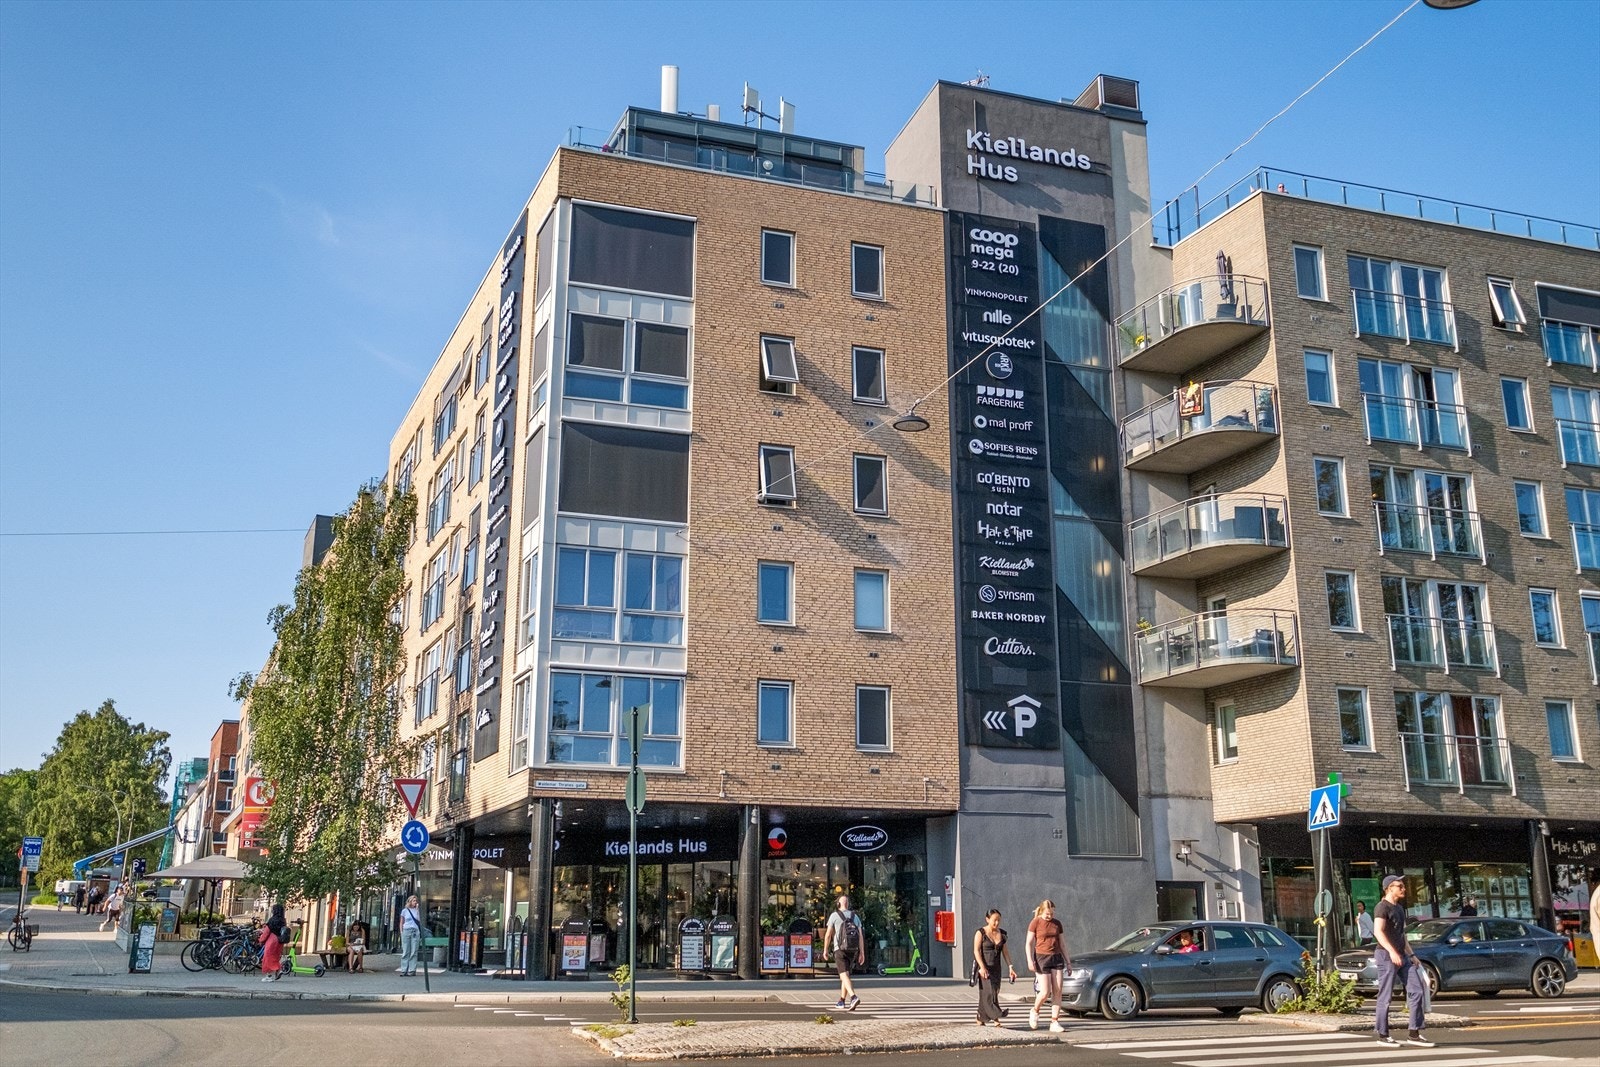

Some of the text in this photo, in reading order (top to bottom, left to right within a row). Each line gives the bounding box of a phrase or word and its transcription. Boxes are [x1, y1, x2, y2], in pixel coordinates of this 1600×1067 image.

[966, 128, 1091, 170] Kiellands
[967, 154, 1018, 182] Hus
[969, 228, 1018, 248] coop
[970, 243, 1014, 260] mega
[971, 259, 1019, 275] 9-22 (20)
[965, 287, 1028, 303] VINMONOPOLET
[982, 309, 1012, 325] nille
[976, 396, 1025, 410] FARGERIKE
[989, 418, 1034, 431] mal proff
[984, 442, 1038, 455] SOFIES RENS
[991, 486, 1015, 494] sushi
[986, 501, 1023, 517] notar
[978, 556, 1027, 570] Kiellands
[991, 569, 1019, 577] BLOMSTER
[997, 590, 1035, 602] SYNSAM
[971, 610, 1046, 623] BAKER NORDBY
[1015, 706, 1037, 737] P
[678, 838, 707, 853] Hus
[1370, 833, 1409, 852] notar
[429, 848, 505, 861] VINMPOLET
